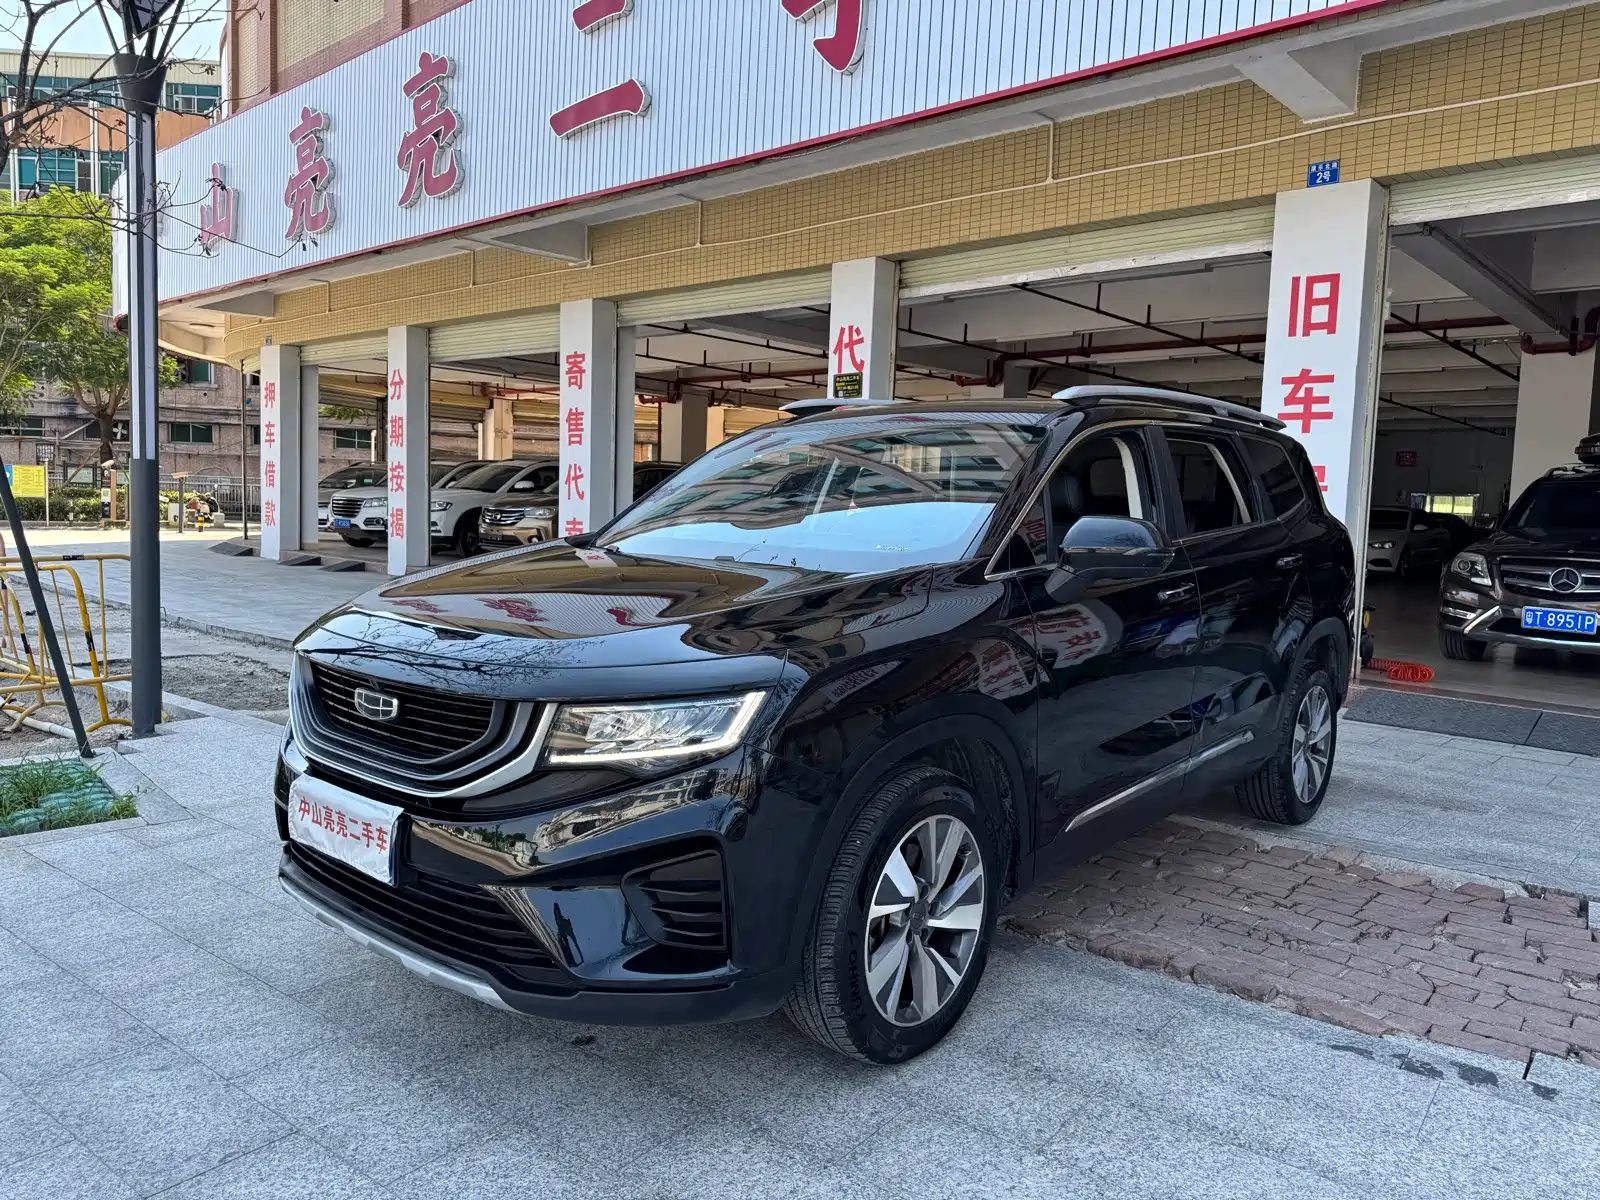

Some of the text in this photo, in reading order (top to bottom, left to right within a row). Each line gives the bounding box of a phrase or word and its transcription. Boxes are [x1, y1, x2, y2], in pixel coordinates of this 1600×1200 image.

[157, 0, 862, 243] 山亮亮二
[1315, 170, 1331, 184] 2号
[833, 325, 865, 373] 代
[1276, 272, 1341, 493] 旧车
[264, 380, 277, 527] 押车借款
[389, 369, 405, 540] 分期按揭
[298, 796, 389, 855] 中山亮亮二手车
